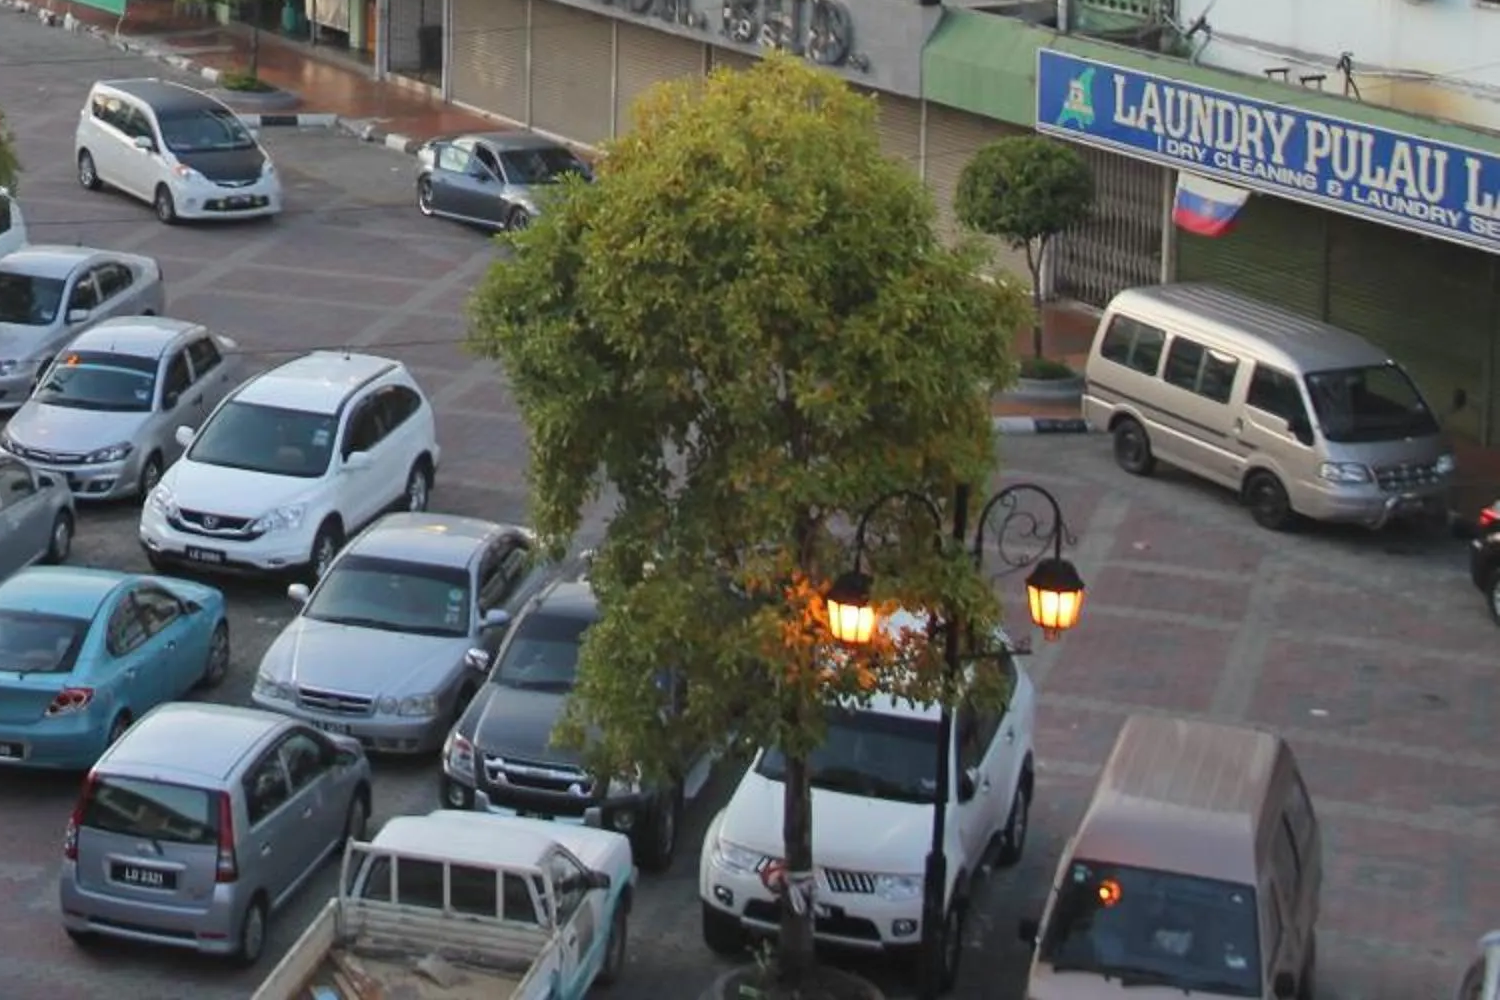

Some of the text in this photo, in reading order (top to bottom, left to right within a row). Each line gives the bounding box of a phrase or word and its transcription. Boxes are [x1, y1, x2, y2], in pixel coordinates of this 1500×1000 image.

[1112, 73, 1296, 165] LAUNDRY
[1304, 119, 1448, 204] PULAU
[1166, 139, 1206, 163] DRY
[1213, 152, 1318, 191] CLEANING
[1352, 185, 1463, 228] LAUNDRY
